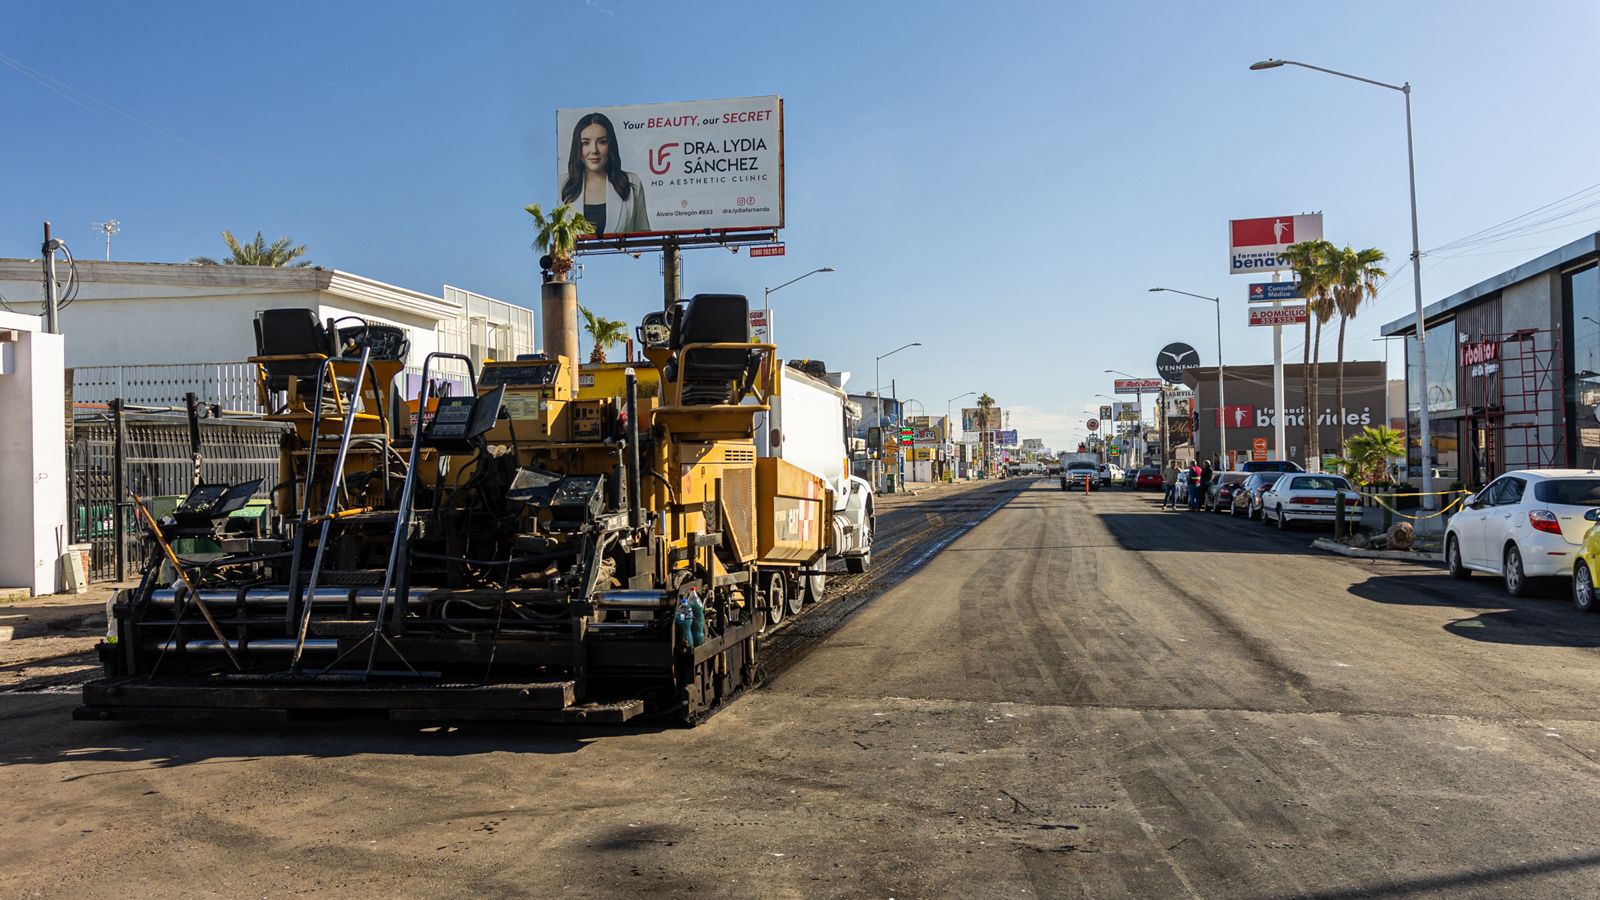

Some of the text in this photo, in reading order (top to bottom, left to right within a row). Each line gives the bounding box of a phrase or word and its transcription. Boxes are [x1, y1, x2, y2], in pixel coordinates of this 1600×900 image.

[623, 110, 773, 130] Your BEAUTY, our SECRET
[684, 138, 767, 155] DRA. LYDIA
[684, 155, 758, 174] SÁNCHEZ
[669, 177, 726, 186] AESTHETIC
[732, 174, 768, 182] CLINIC
[674, 209, 697, 217] Obregón
[1232, 256, 1291, 269] benavi
[1260, 309, 1305, 317] DOMICILIO
